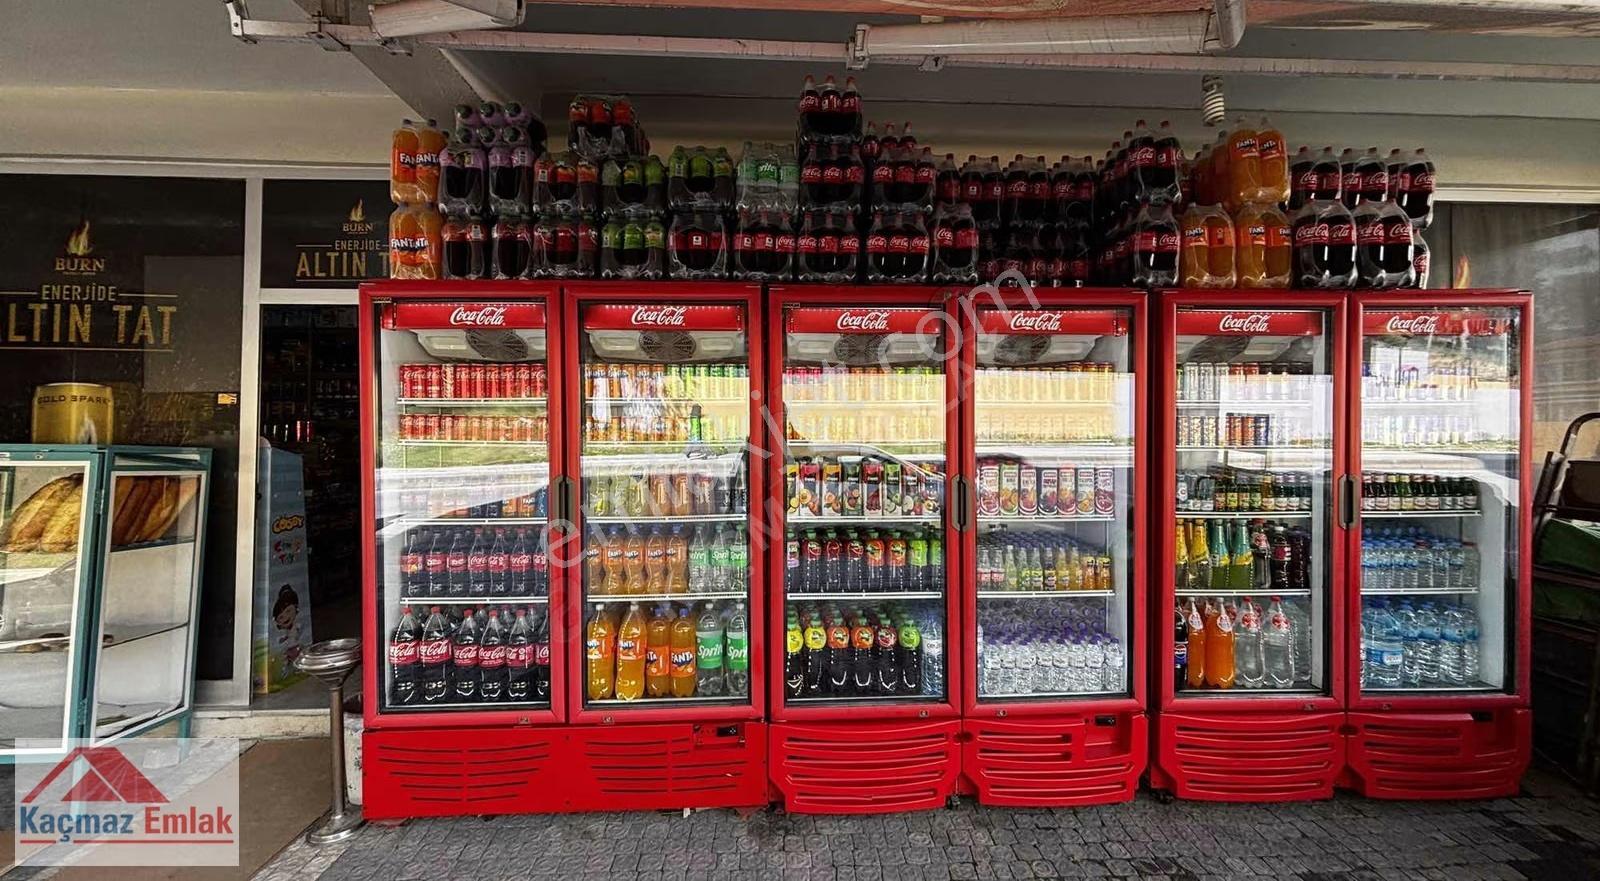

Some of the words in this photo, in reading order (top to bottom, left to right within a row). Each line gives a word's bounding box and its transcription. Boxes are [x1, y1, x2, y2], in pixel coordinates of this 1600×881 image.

[343, 223, 373, 232] BURN
[55, 257, 105, 271] BURN
[296, 252, 366, 277] ALTIN
[41, 283, 117, 301] ENERJİDE
[0, 303, 92, 343] LTIN
[112, 305, 177, 345] TAT
[449, 306, 506, 326] Coca-Cola
[631, 306, 686, 326] Coca-Cola
[837, 312, 889, 331] Coca-Cola
[1010, 312, 1062, 332] Coca-Cola
[1219, 315, 1271, 333] Coca-Cola
[1386, 315, 1438, 334] Coca-Cola
[671, 651, 694, 665] FANTA
